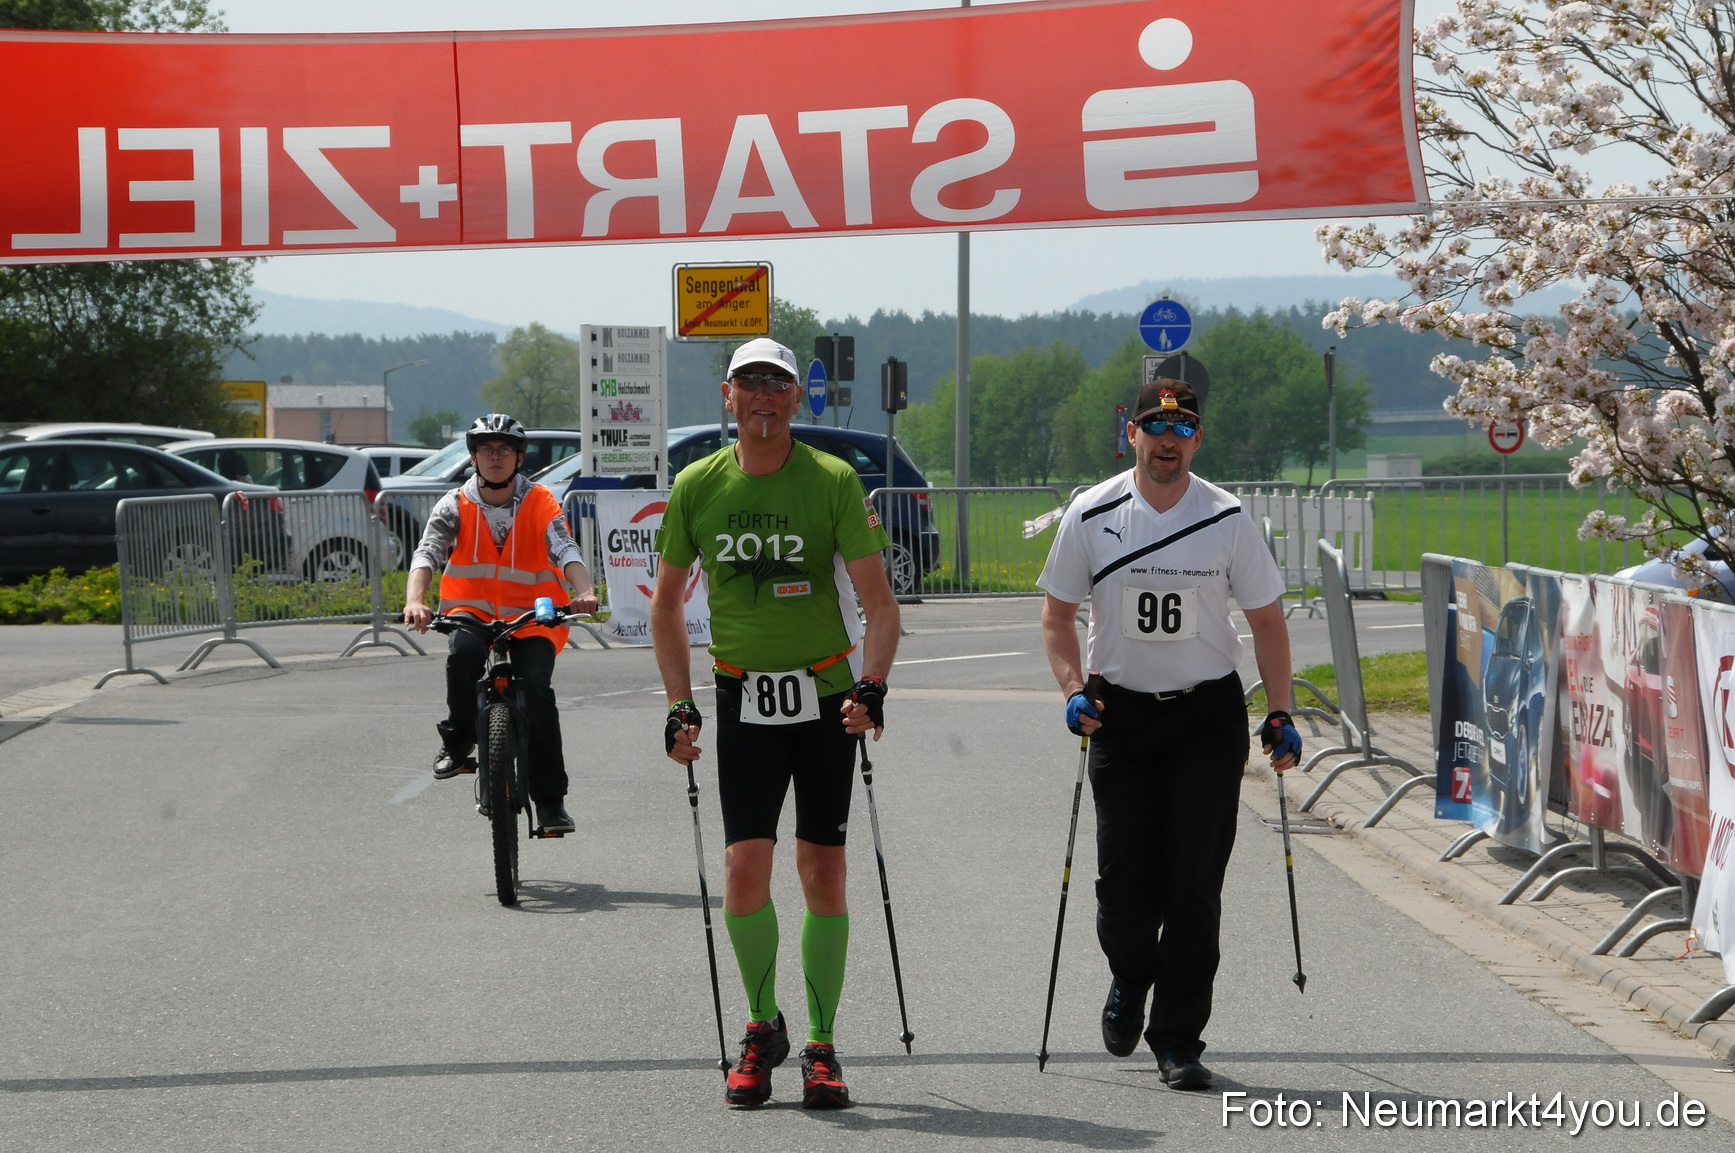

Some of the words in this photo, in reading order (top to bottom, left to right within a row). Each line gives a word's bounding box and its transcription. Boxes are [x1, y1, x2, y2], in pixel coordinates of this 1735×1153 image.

[686, 275, 761, 298] Sengenthal
[696, 300, 713, 309] am
[718, 299, 751, 311] Anger
[704, 318, 738, 328] Neumarkt
[617, 328, 650, 339] HOLZAMMER
[617, 352, 651, 364] HOLZAMMER
[600, 379, 617, 398] SHB
[600, 429, 628, 447] THULE
[727, 510, 788, 530] FÜRTH
[608, 528, 660, 553] GERH
[715, 533, 804, 562] 2012
[609, 554, 647, 567] Autohaus
[777, 584, 808, 595] OBI
[1137, 591, 1182, 635] 96
[756, 674, 802, 718] 80
